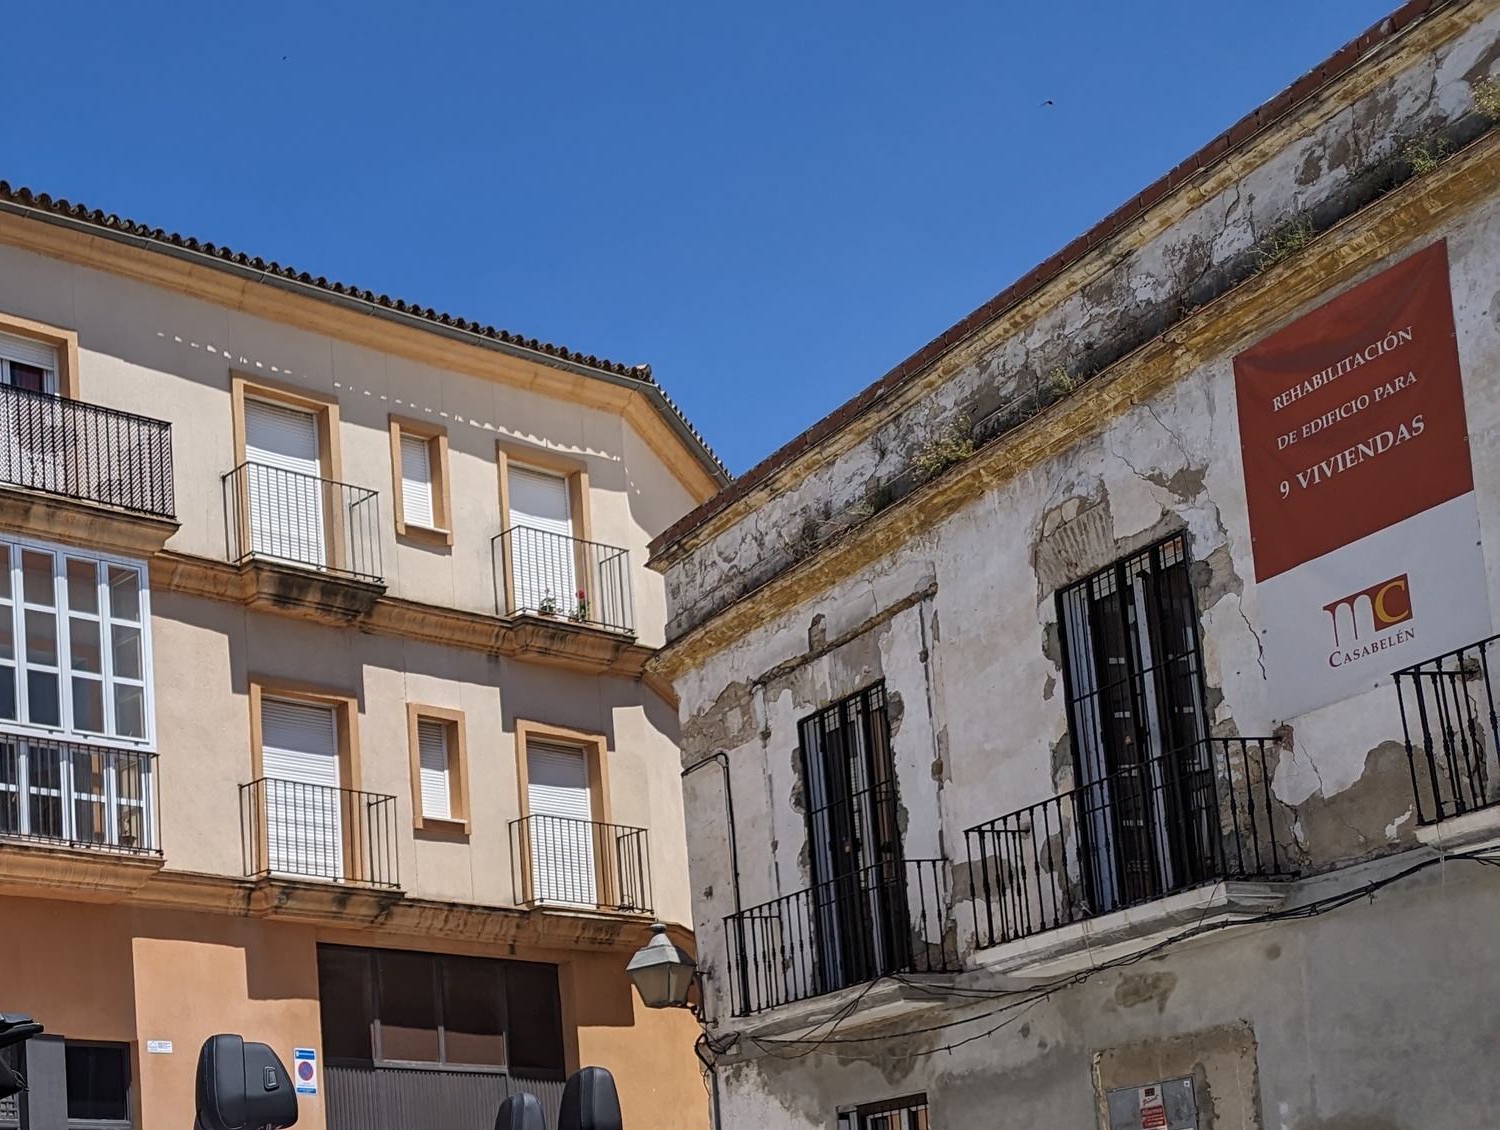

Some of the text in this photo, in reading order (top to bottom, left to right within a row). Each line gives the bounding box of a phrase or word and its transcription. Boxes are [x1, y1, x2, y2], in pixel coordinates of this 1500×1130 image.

[1272, 325, 1413, 412] REHABILITACIÓN
[1277, 371, 1418, 451] DE EDIFICIO PARA
[1279, 414, 1425, 500] 9 VIVIENDAS
